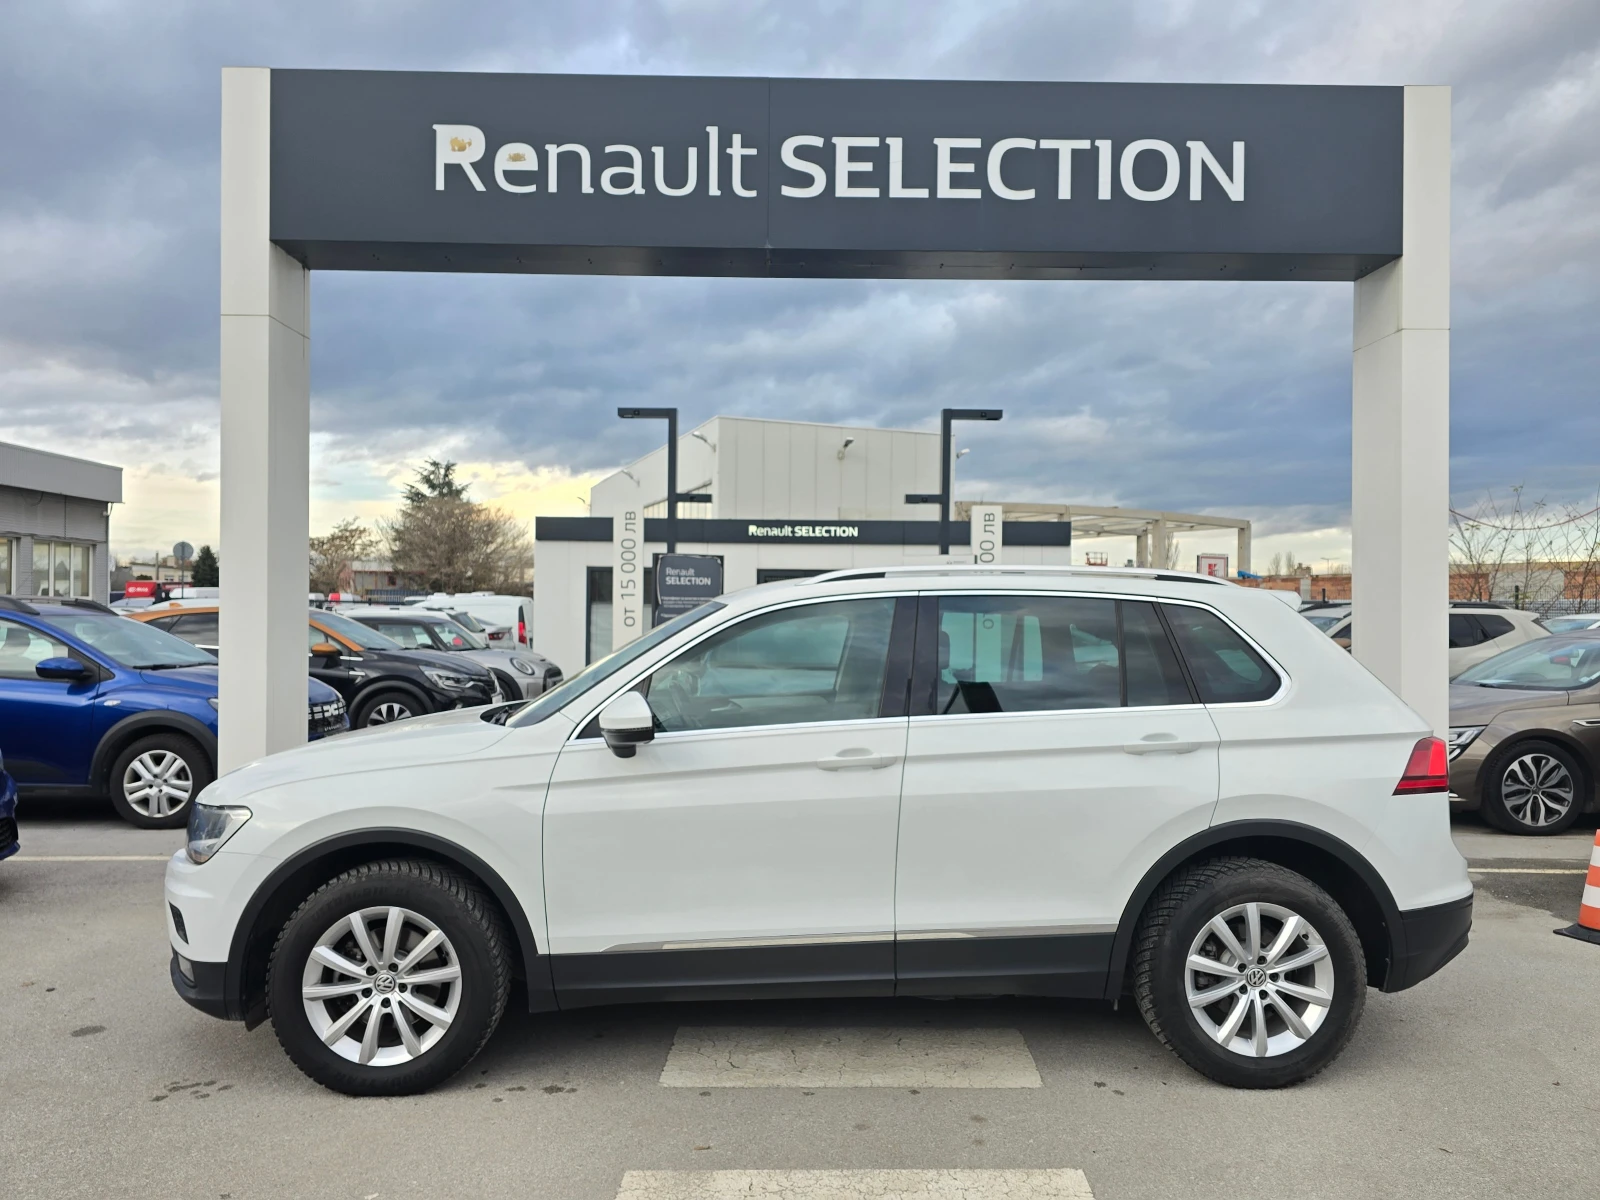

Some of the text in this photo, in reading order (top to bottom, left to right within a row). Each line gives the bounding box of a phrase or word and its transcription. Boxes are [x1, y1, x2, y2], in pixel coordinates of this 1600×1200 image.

[432, 124, 1245, 202] Renault SELECTION
[748, 524, 859, 538] Renault SELECTION
[620, 538, 636, 573] 000
[665, 566, 695, 577] Renault
[620, 579, 636, 600] 15
[665, 576, 712, 586] SELECTION
